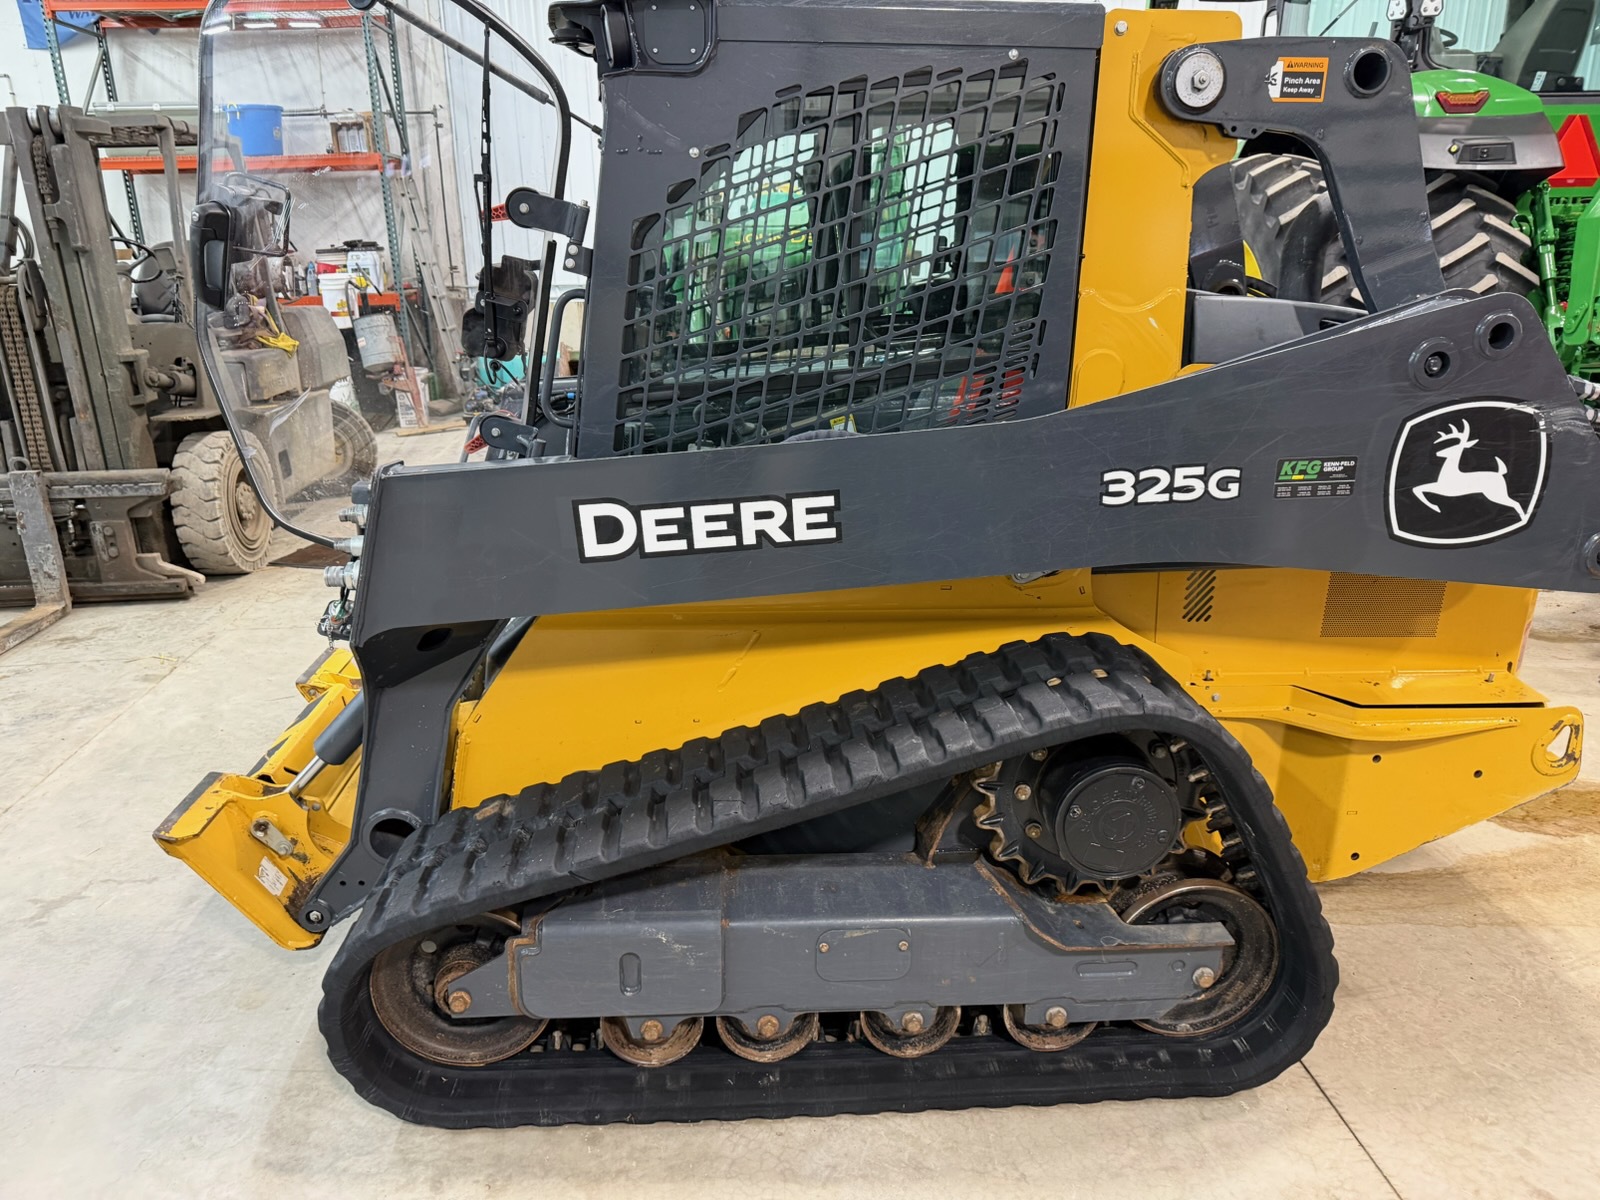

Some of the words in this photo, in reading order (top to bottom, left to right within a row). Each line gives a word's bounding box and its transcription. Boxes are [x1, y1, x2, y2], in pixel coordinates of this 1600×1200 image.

[1102, 466, 1241, 505] 325G
[1280, 460, 1322, 475] KFG
[578, 495, 837, 558] DEERE
